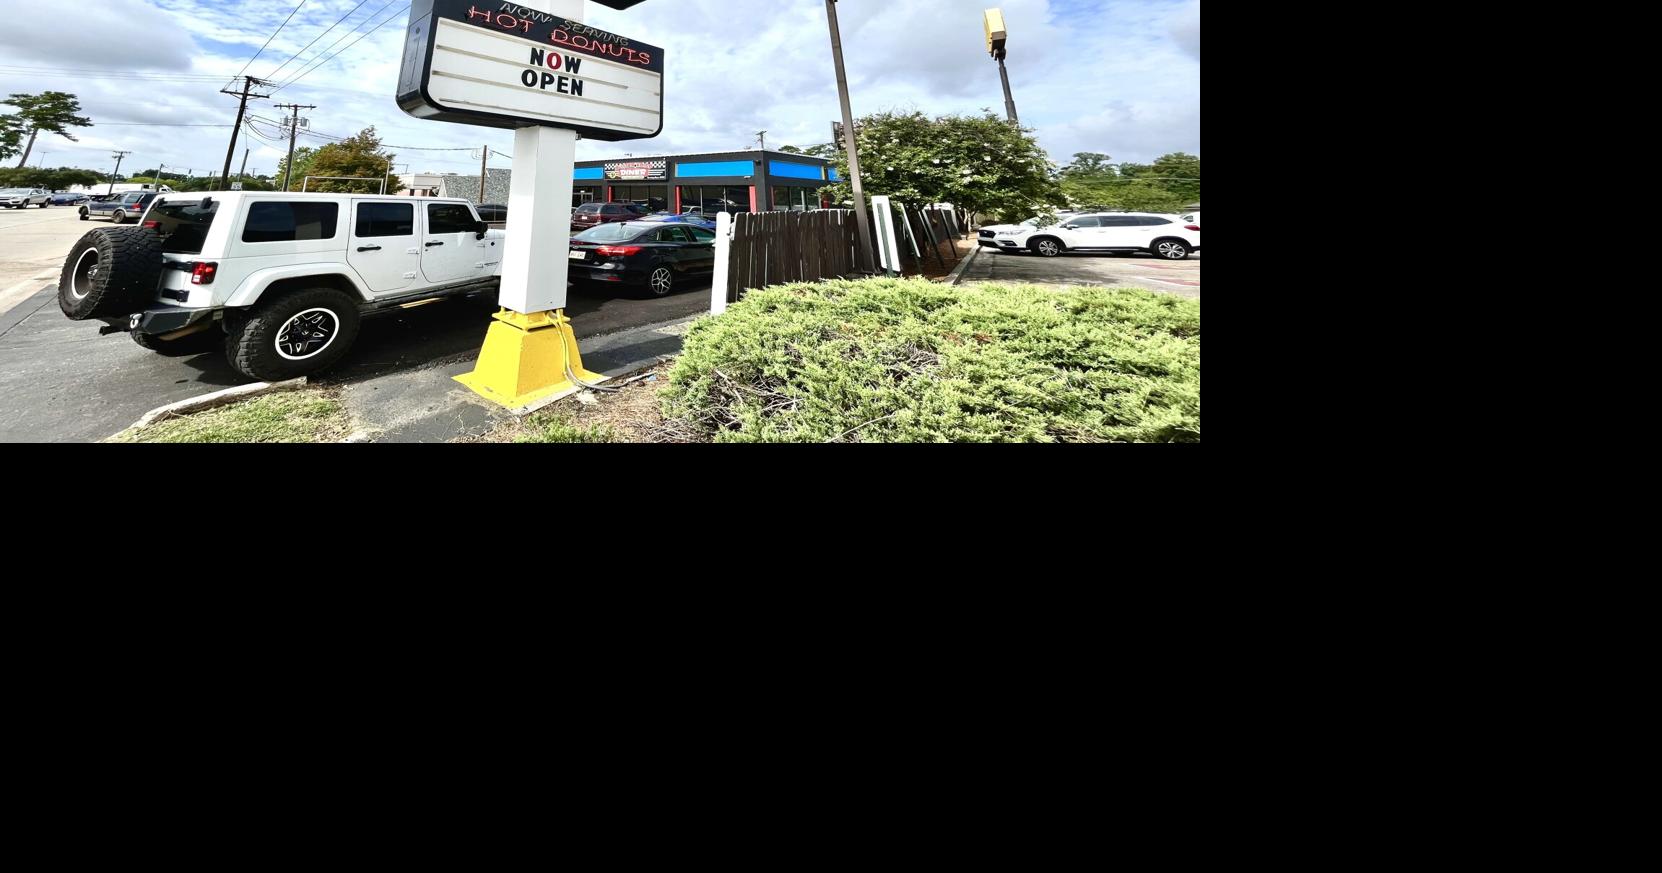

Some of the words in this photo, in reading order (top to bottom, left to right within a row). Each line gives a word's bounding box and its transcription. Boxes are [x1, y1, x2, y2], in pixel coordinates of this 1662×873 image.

[468, 6, 534, 33] HOT
[550, 29, 650, 65] DONUTS
[560, 20, 630, 46] SERVING
[529, 47, 582, 74] NOW
[521, 69, 583, 97] OPEN
